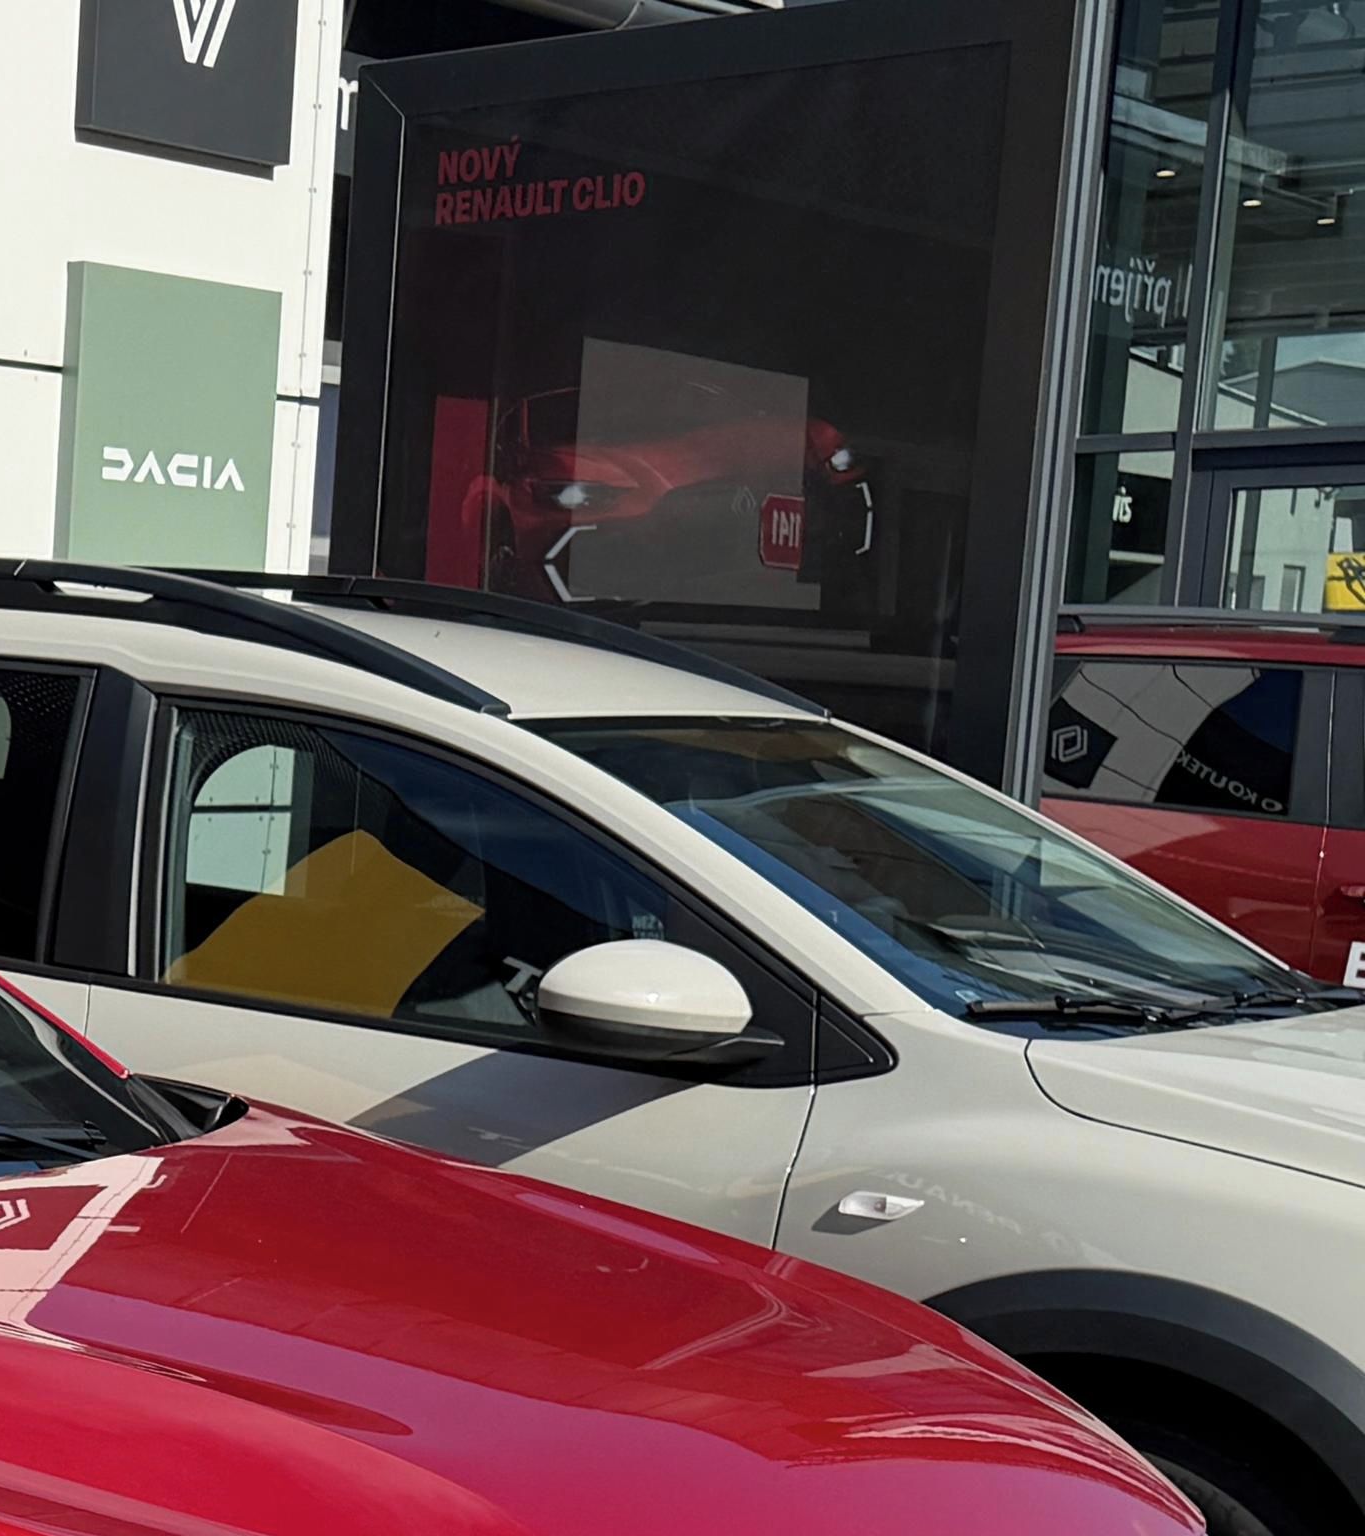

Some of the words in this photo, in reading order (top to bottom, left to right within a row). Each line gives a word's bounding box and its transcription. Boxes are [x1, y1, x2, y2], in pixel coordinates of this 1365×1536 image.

[438, 134, 521, 185] NOVÝ
[435, 179, 568, 225] RENAULT
[572, 171, 646, 211] CLIO
[101, 446, 245, 492] DACIA
